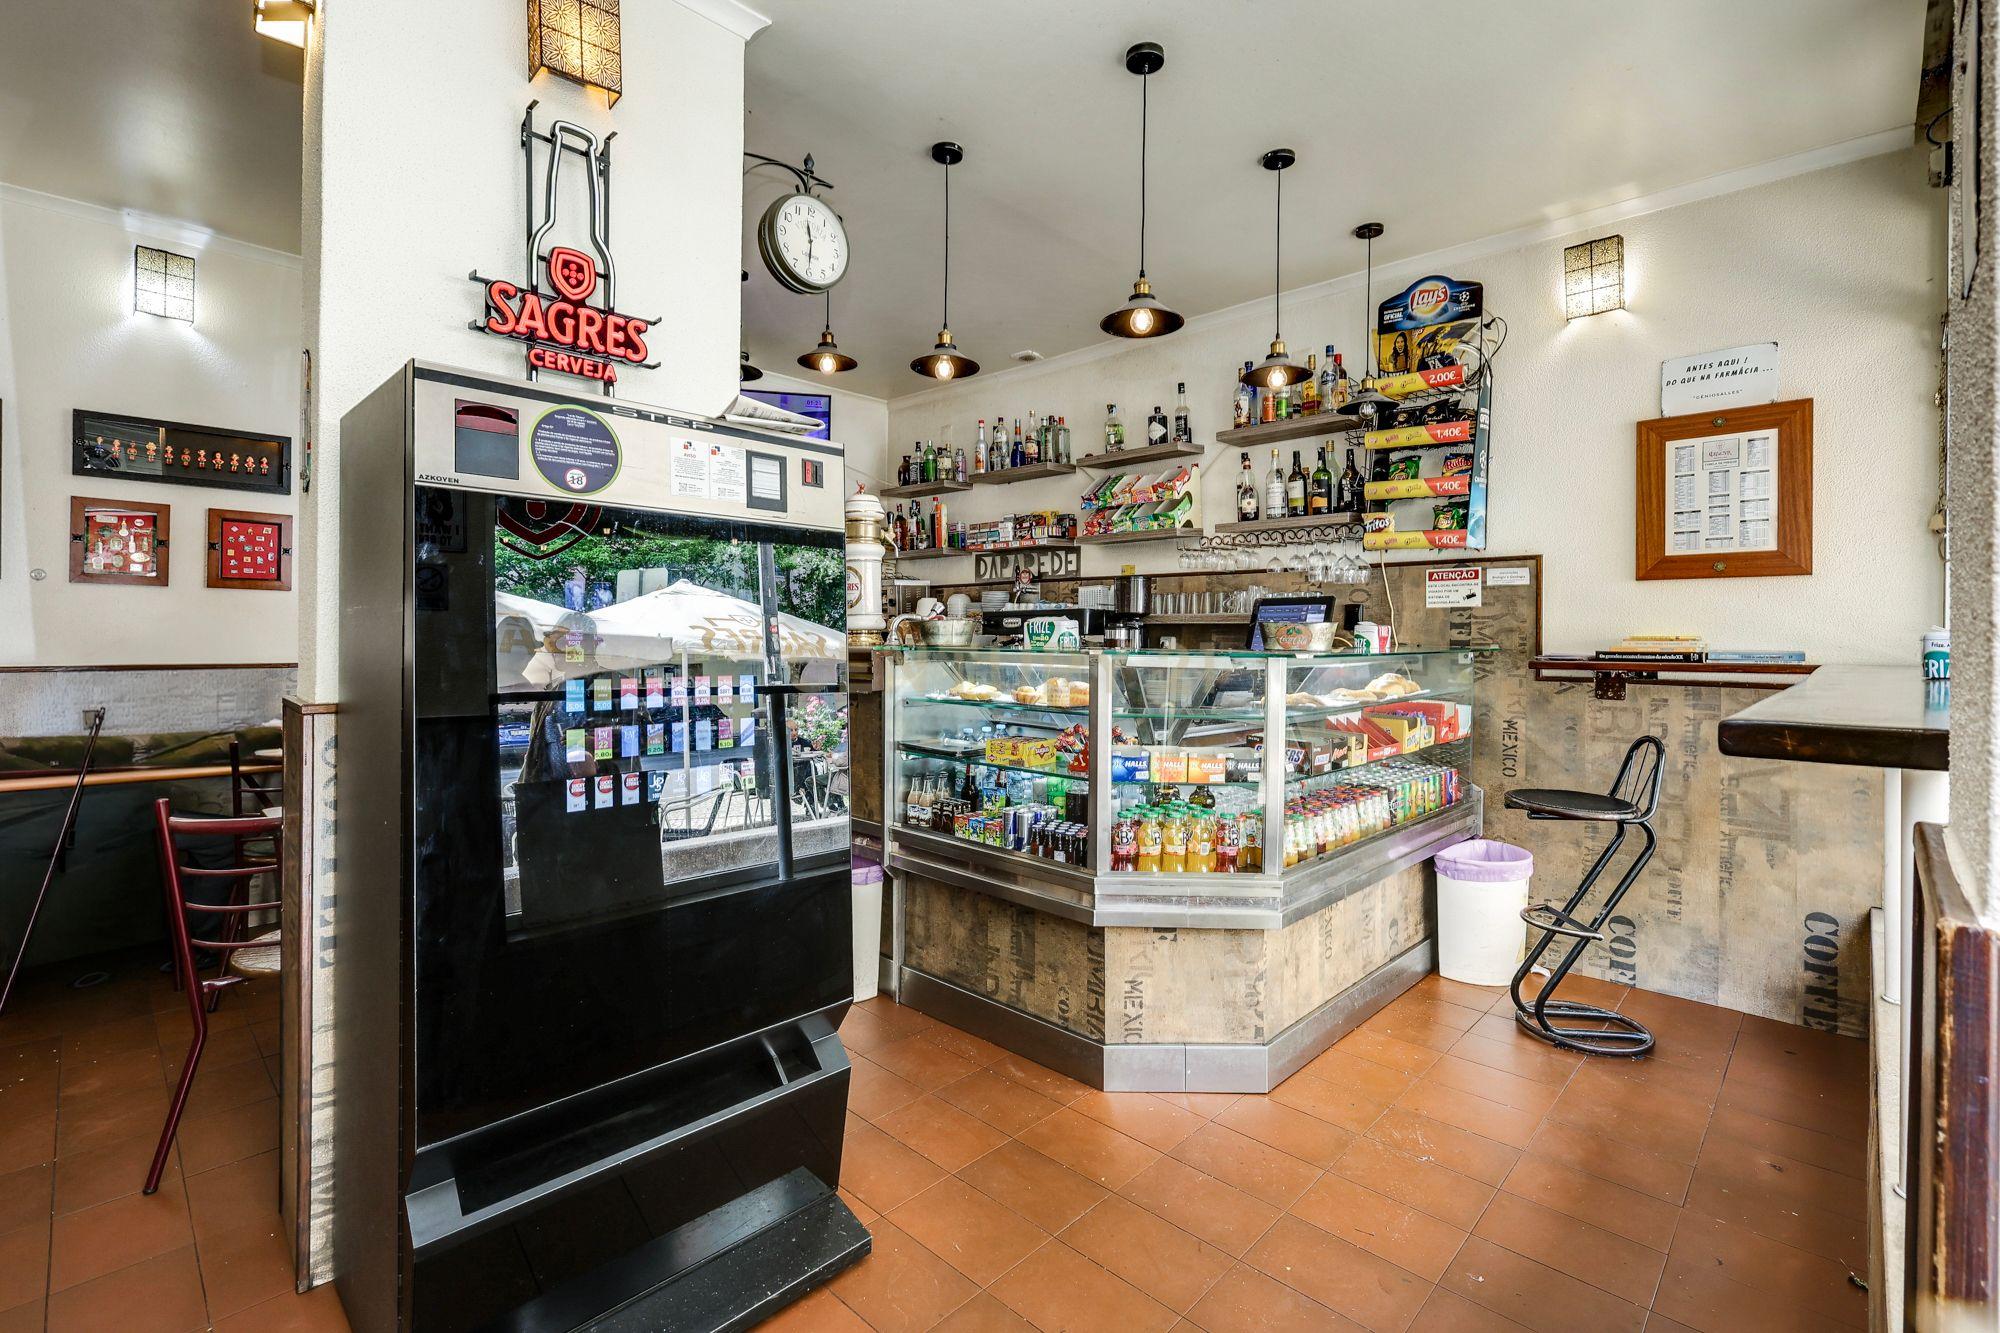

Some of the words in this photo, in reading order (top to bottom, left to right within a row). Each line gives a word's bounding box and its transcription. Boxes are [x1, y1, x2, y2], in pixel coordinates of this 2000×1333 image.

[794, 205, 801, 216] 11
[807, 206, 816, 218] 12
[779, 224, 786, 236] 9
[830, 233, 837, 243] 2
[783, 242, 790, 253] 8
[833, 248, 839, 259] 3
[793, 258, 798, 268] 7
[830, 263, 835, 272] 4
[805, 267, 812, 278] 6
[820, 270, 826, 279] 5
[487, 280, 648, 362] SAGRES
[1384, 312, 1403, 320] OFICIAL
[528, 348, 617, 382] CERVEJA
[1686, 362, 1714, 373] ANTES
[1718, 358, 1740, 368] AQUI
[1430, 370, 1456, 383] 2,00€
[1715, 366, 1759, 379] FARMÁCIA
[1437, 427, 1462, 438] 1,40€
[418, 474, 460, 484] AZKOYEN
[1436, 480, 1461, 491] 1,40€
[1434, 535, 1459, 545] 1,40€
[1029, 622, 1051, 634] FRIZE
[1502, 719, 1519, 778] MEXICO
[1124, 760, 1147, 768] HALLS
